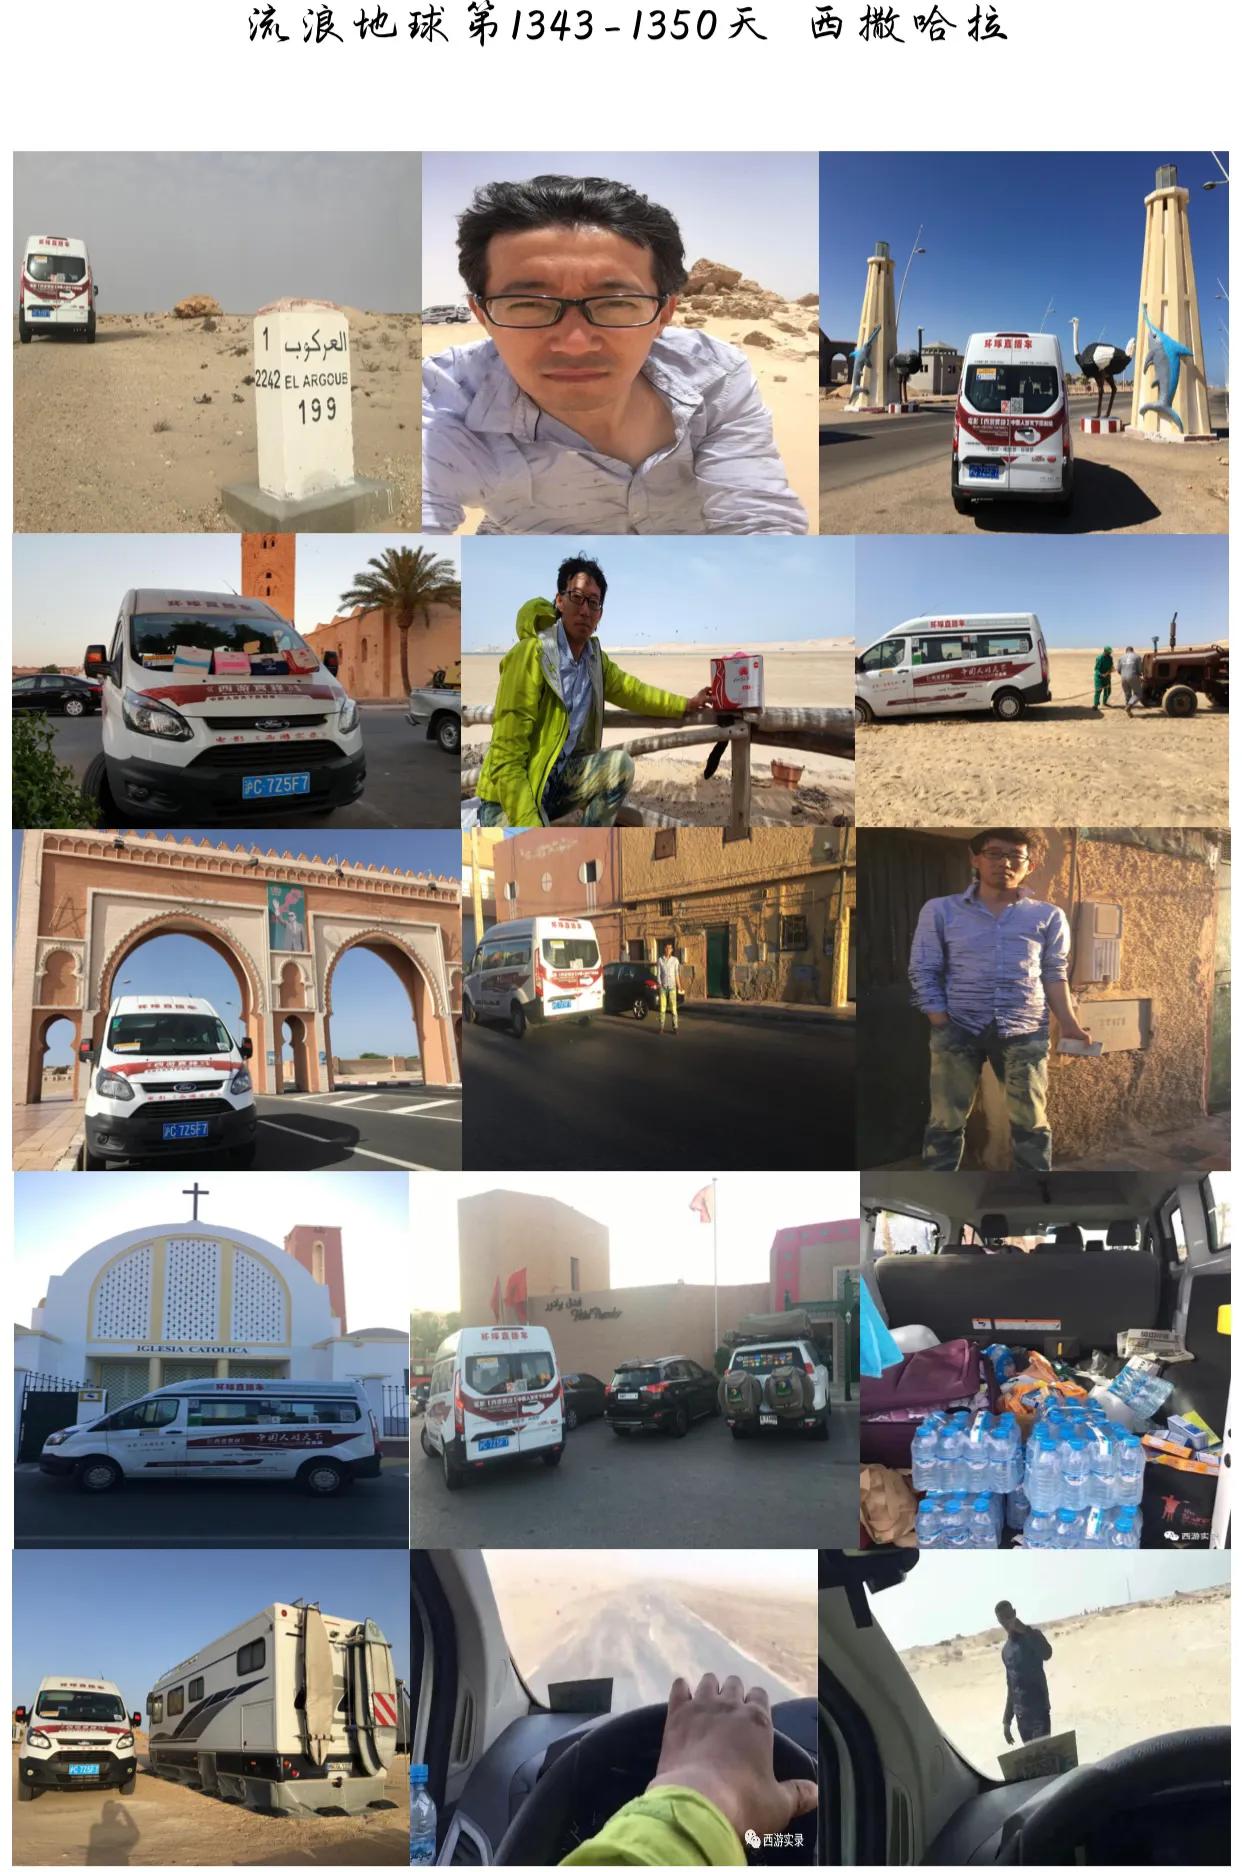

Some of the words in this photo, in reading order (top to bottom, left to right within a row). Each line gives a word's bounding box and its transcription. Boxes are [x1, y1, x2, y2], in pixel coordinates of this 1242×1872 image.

[263, 326, 269, 351] 1
[255, 368, 281, 390] 2242
[285, 375, 300, 389] EL
[303, 372, 349, 388] ARGOUB
[299, 396, 337, 424] 199
[137, 1345, 184, 1353] IGLESIA
[188, 1346, 249, 1354] CATOLICA
